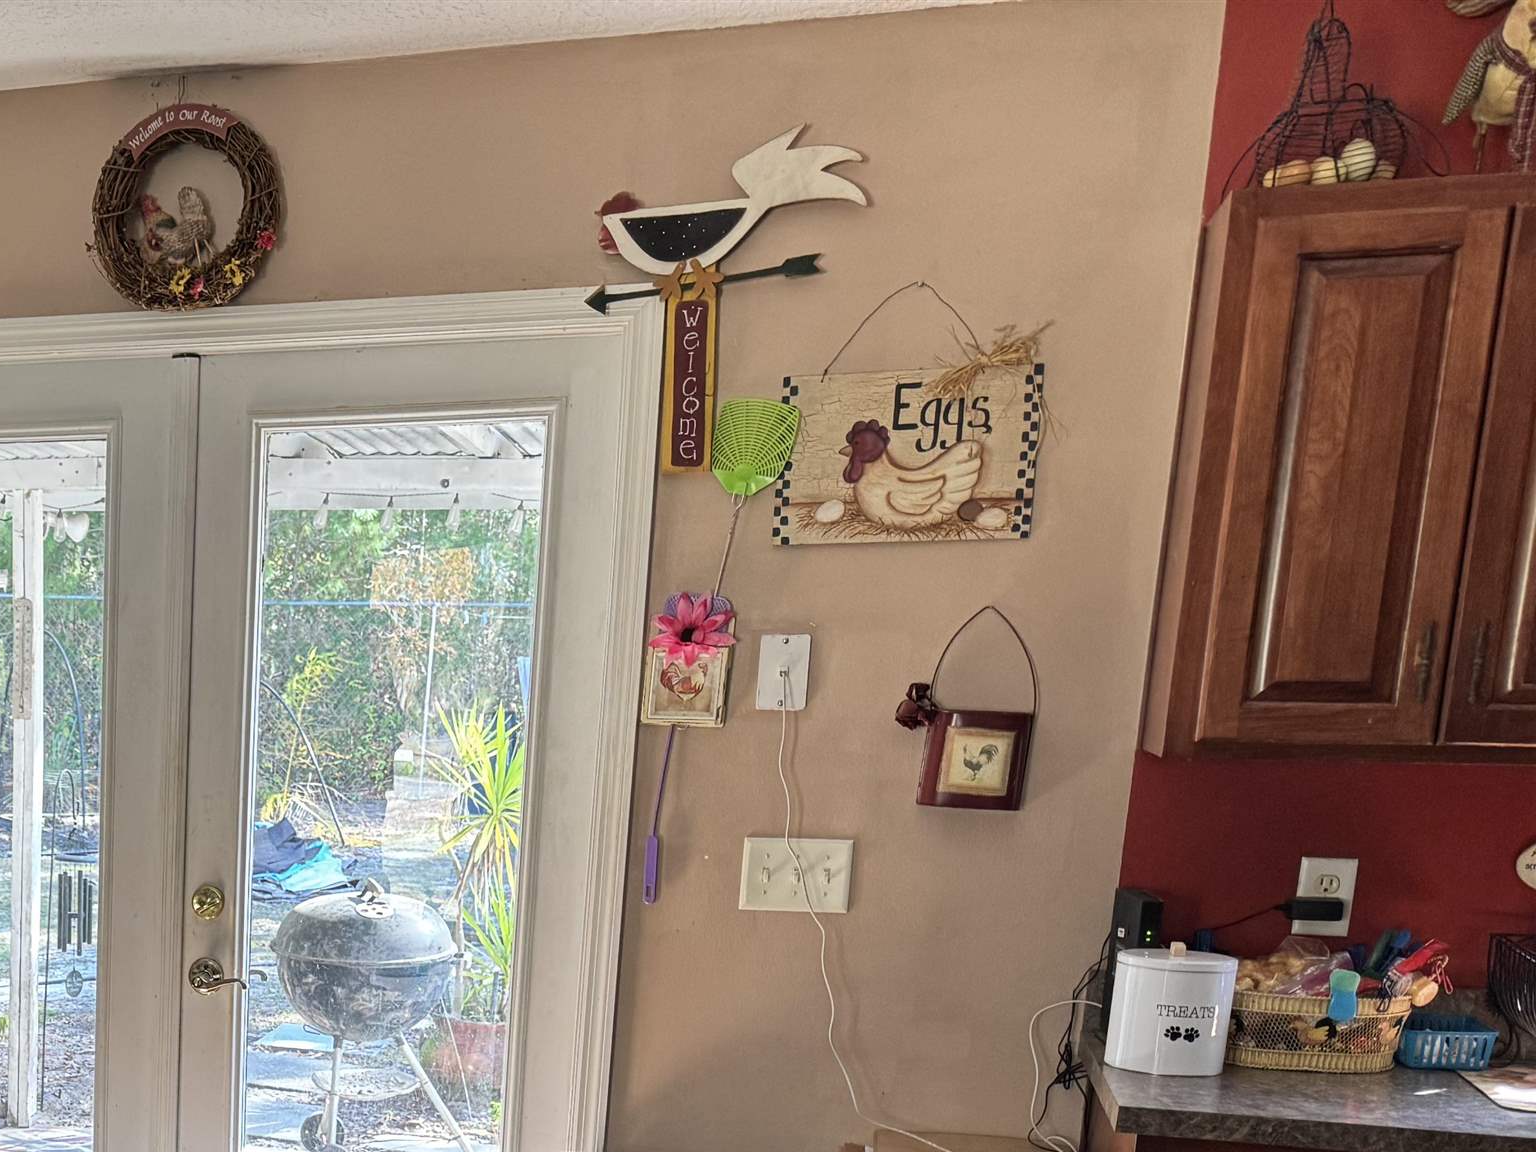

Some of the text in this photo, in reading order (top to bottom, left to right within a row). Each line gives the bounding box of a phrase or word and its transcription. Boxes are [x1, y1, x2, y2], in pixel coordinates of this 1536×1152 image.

[129, 109, 227, 149] Welcome to Our Roost
[678, 305, 704, 461] Welcome
[892, 381, 993, 453] Eggs
[1156, 1003, 1216, 1019] TREATS
